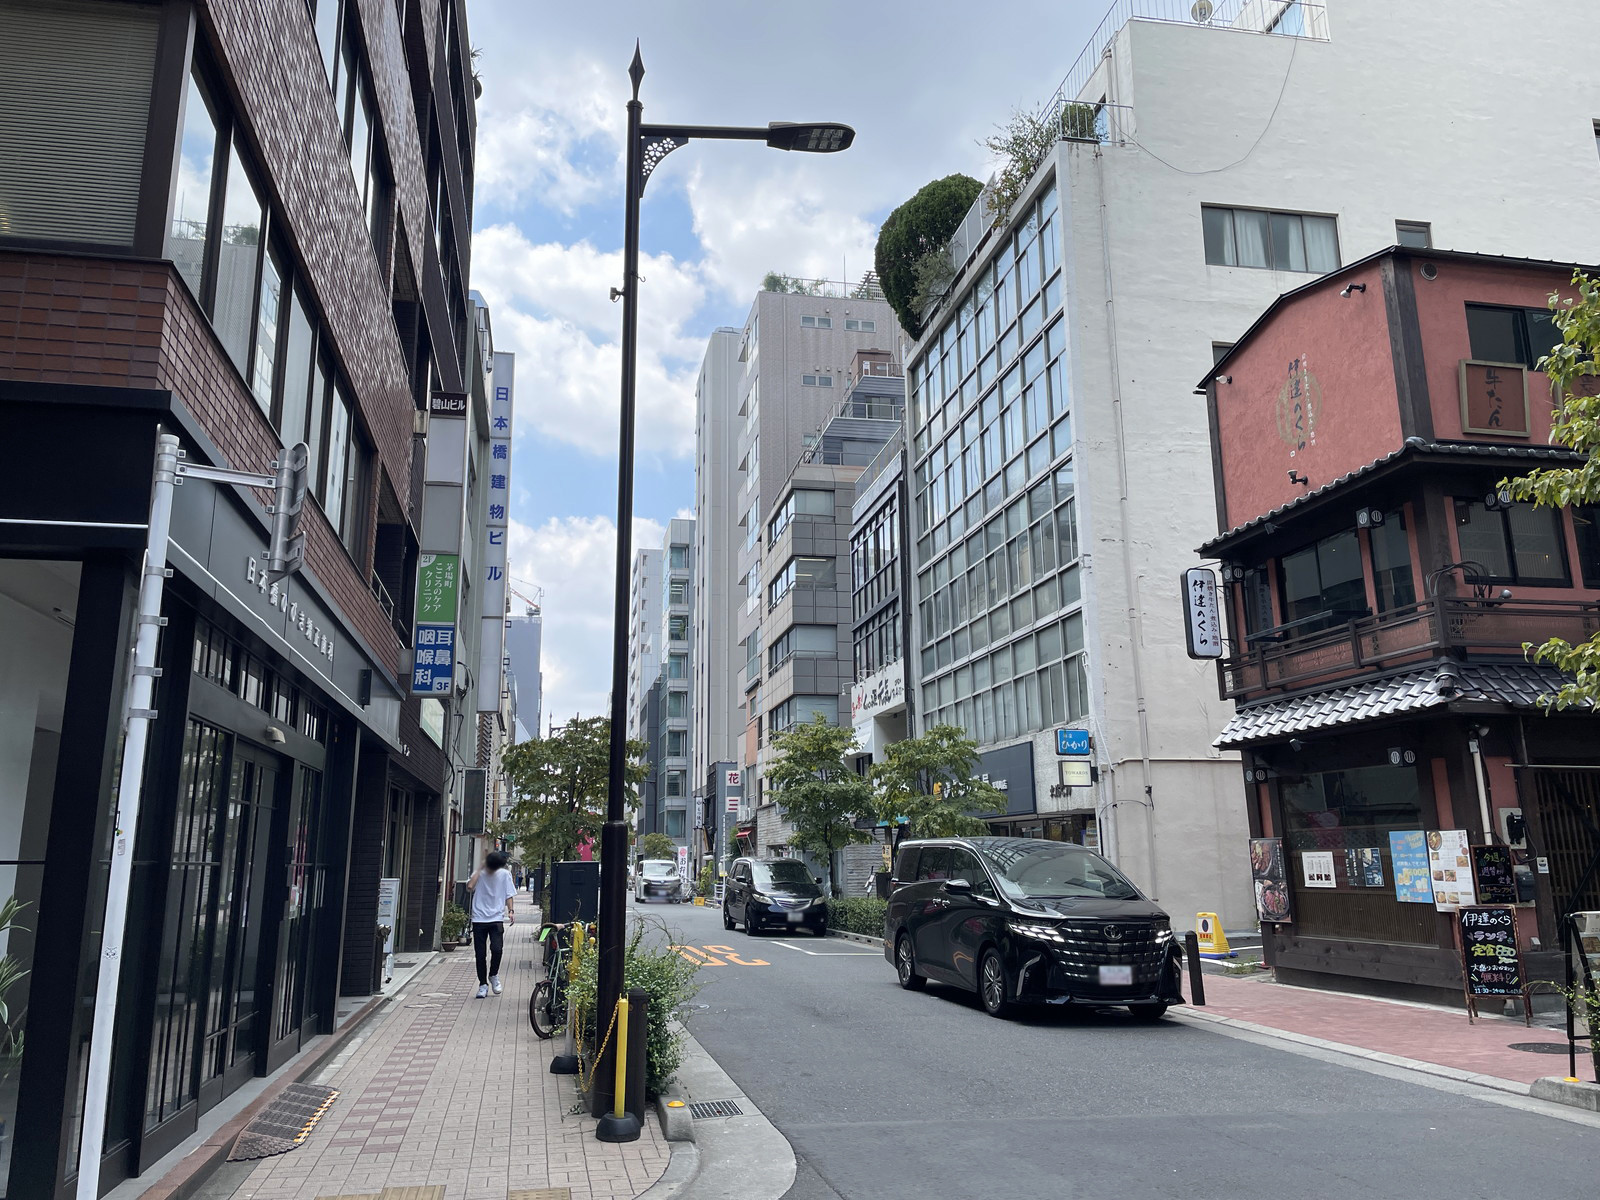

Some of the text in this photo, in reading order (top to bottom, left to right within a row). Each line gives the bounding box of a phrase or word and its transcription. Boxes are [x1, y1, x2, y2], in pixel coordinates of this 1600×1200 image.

[1288, 359, 1306, 451] 伊達のくら
[1485, 368, 1503, 427] 牛たん
[487, 387, 509, 581] 日本橋建物ビル
[422, 555, 433, 563] 2F
[443, 562, 454, 589] 茅場町
[422, 570, 433, 613] クリニック
[433, 562, 443, 613] こころのケア
[1192, 579, 1208, 646] 伊達のくら
[414, 629, 435, 685] 咽喉科
[434, 629, 453, 666] 耳鼻
[436, 682, 449, 691] 3F
[1061, 740, 1088, 751] ひかり
[1462, 911, 1511, 927] 伊達のくら
[1474, 930, 1508, 942] ランチ
